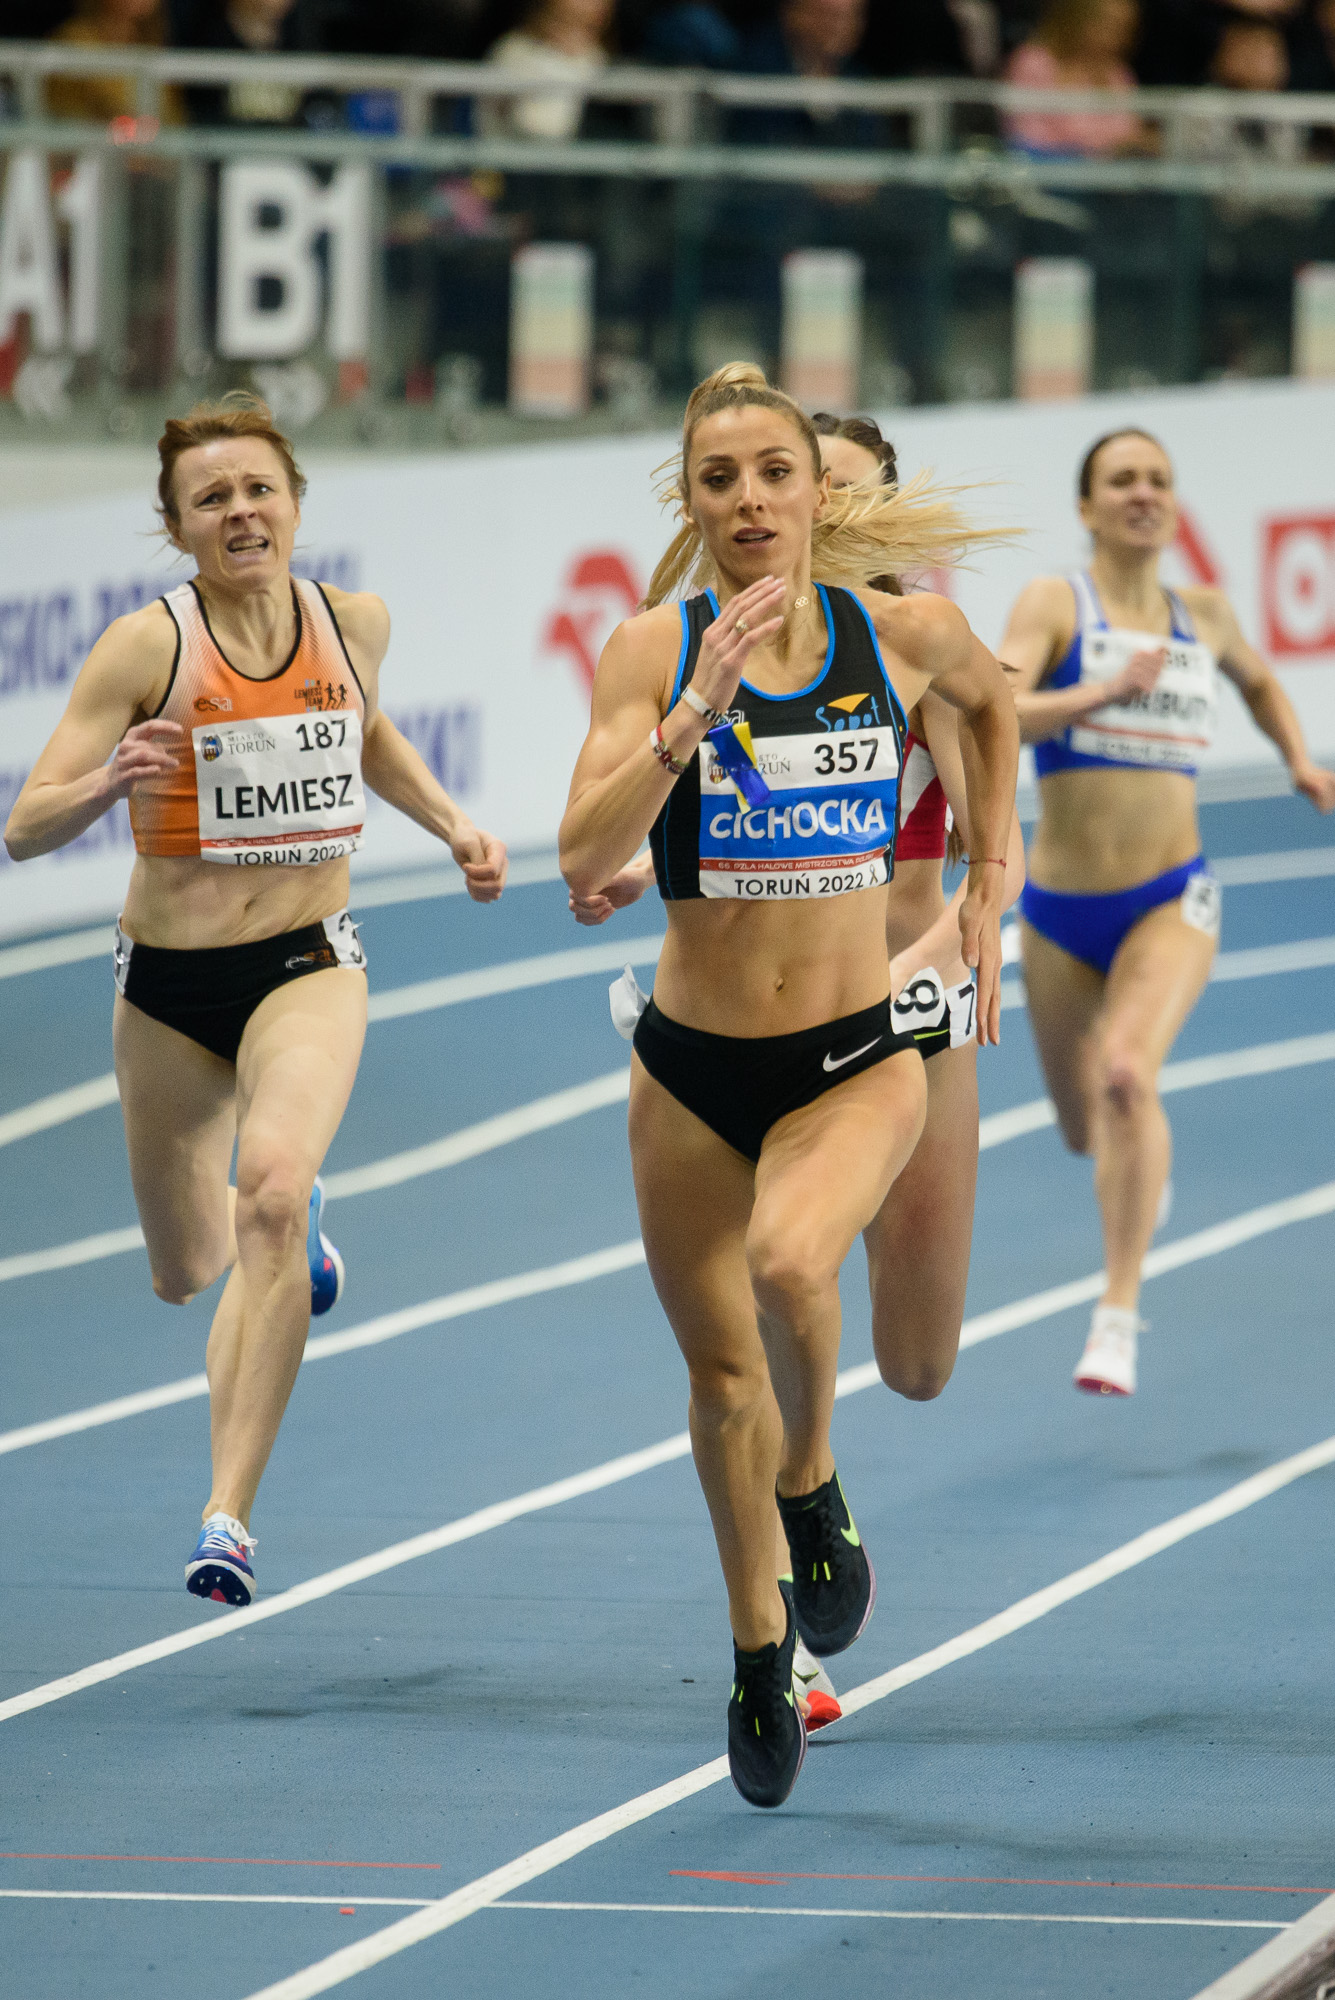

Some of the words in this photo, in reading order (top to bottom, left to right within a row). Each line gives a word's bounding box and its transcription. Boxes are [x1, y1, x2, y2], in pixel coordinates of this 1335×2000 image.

[218, 158, 371, 358] B1
[295, 717, 349, 752] 187
[814, 738, 879, 775] 357
[215, 774, 354, 819] LEMIESZ
[709, 798, 887, 839] CICHOCKA
[234, 844, 301, 866] TORUŃ
[308, 843, 346, 863] 2022
[733, 861, 757, 871] PZLA
[758, 860, 794, 870] HALOWE
[795, 858, 855, 869] MISTRZOSTWA
[735, 873, 810, 896] TORUŃ
[818, 872, 864, 894] 2022
